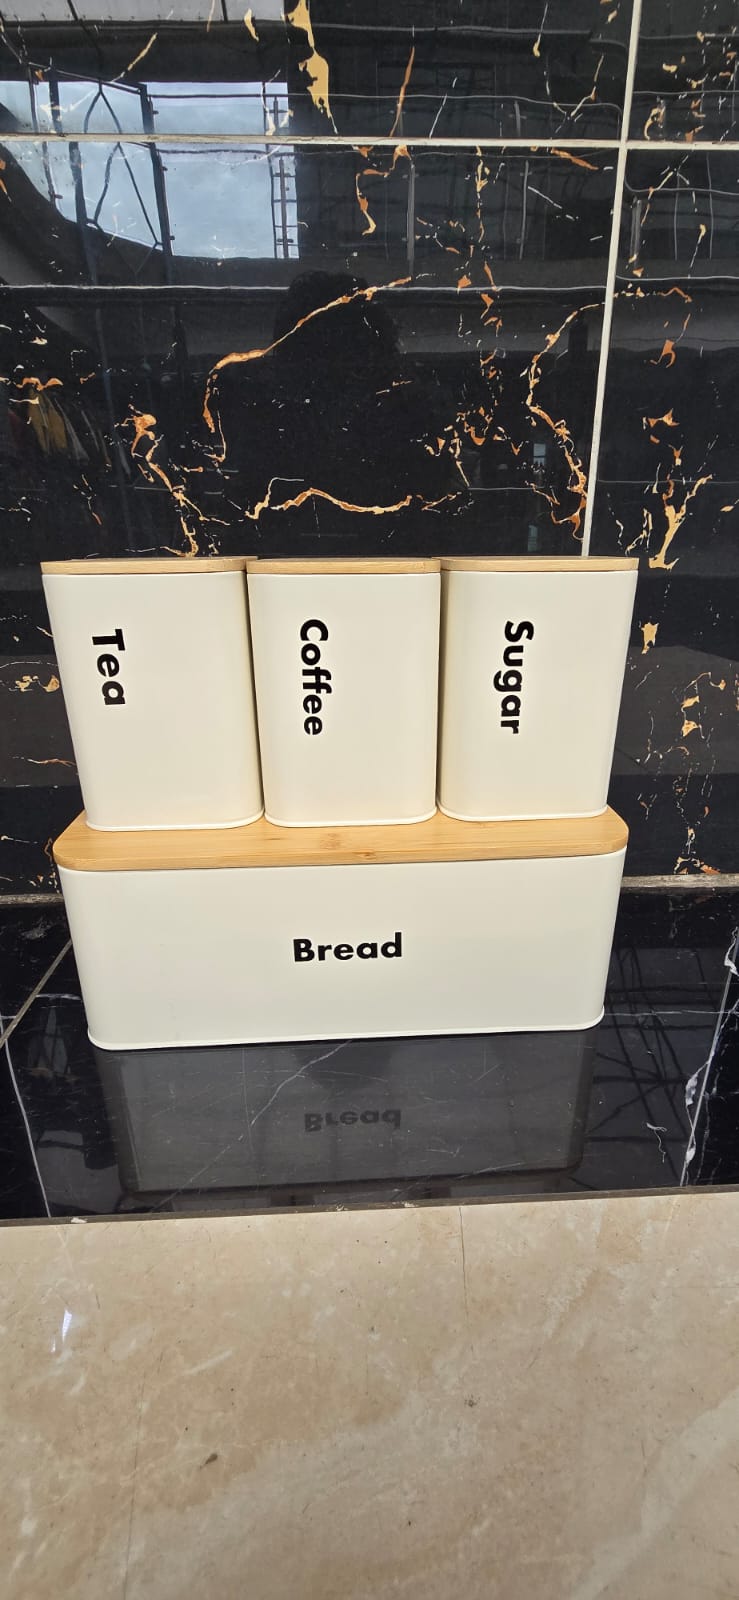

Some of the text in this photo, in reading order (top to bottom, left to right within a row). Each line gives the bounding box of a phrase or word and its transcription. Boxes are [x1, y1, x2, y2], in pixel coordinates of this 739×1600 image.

[91, 628, 126, 706] Tea
[300, 618, 333, 736] Coffee
[493, 620, 535, 735] Sugar
[293, 932, 403, 963] Bread
